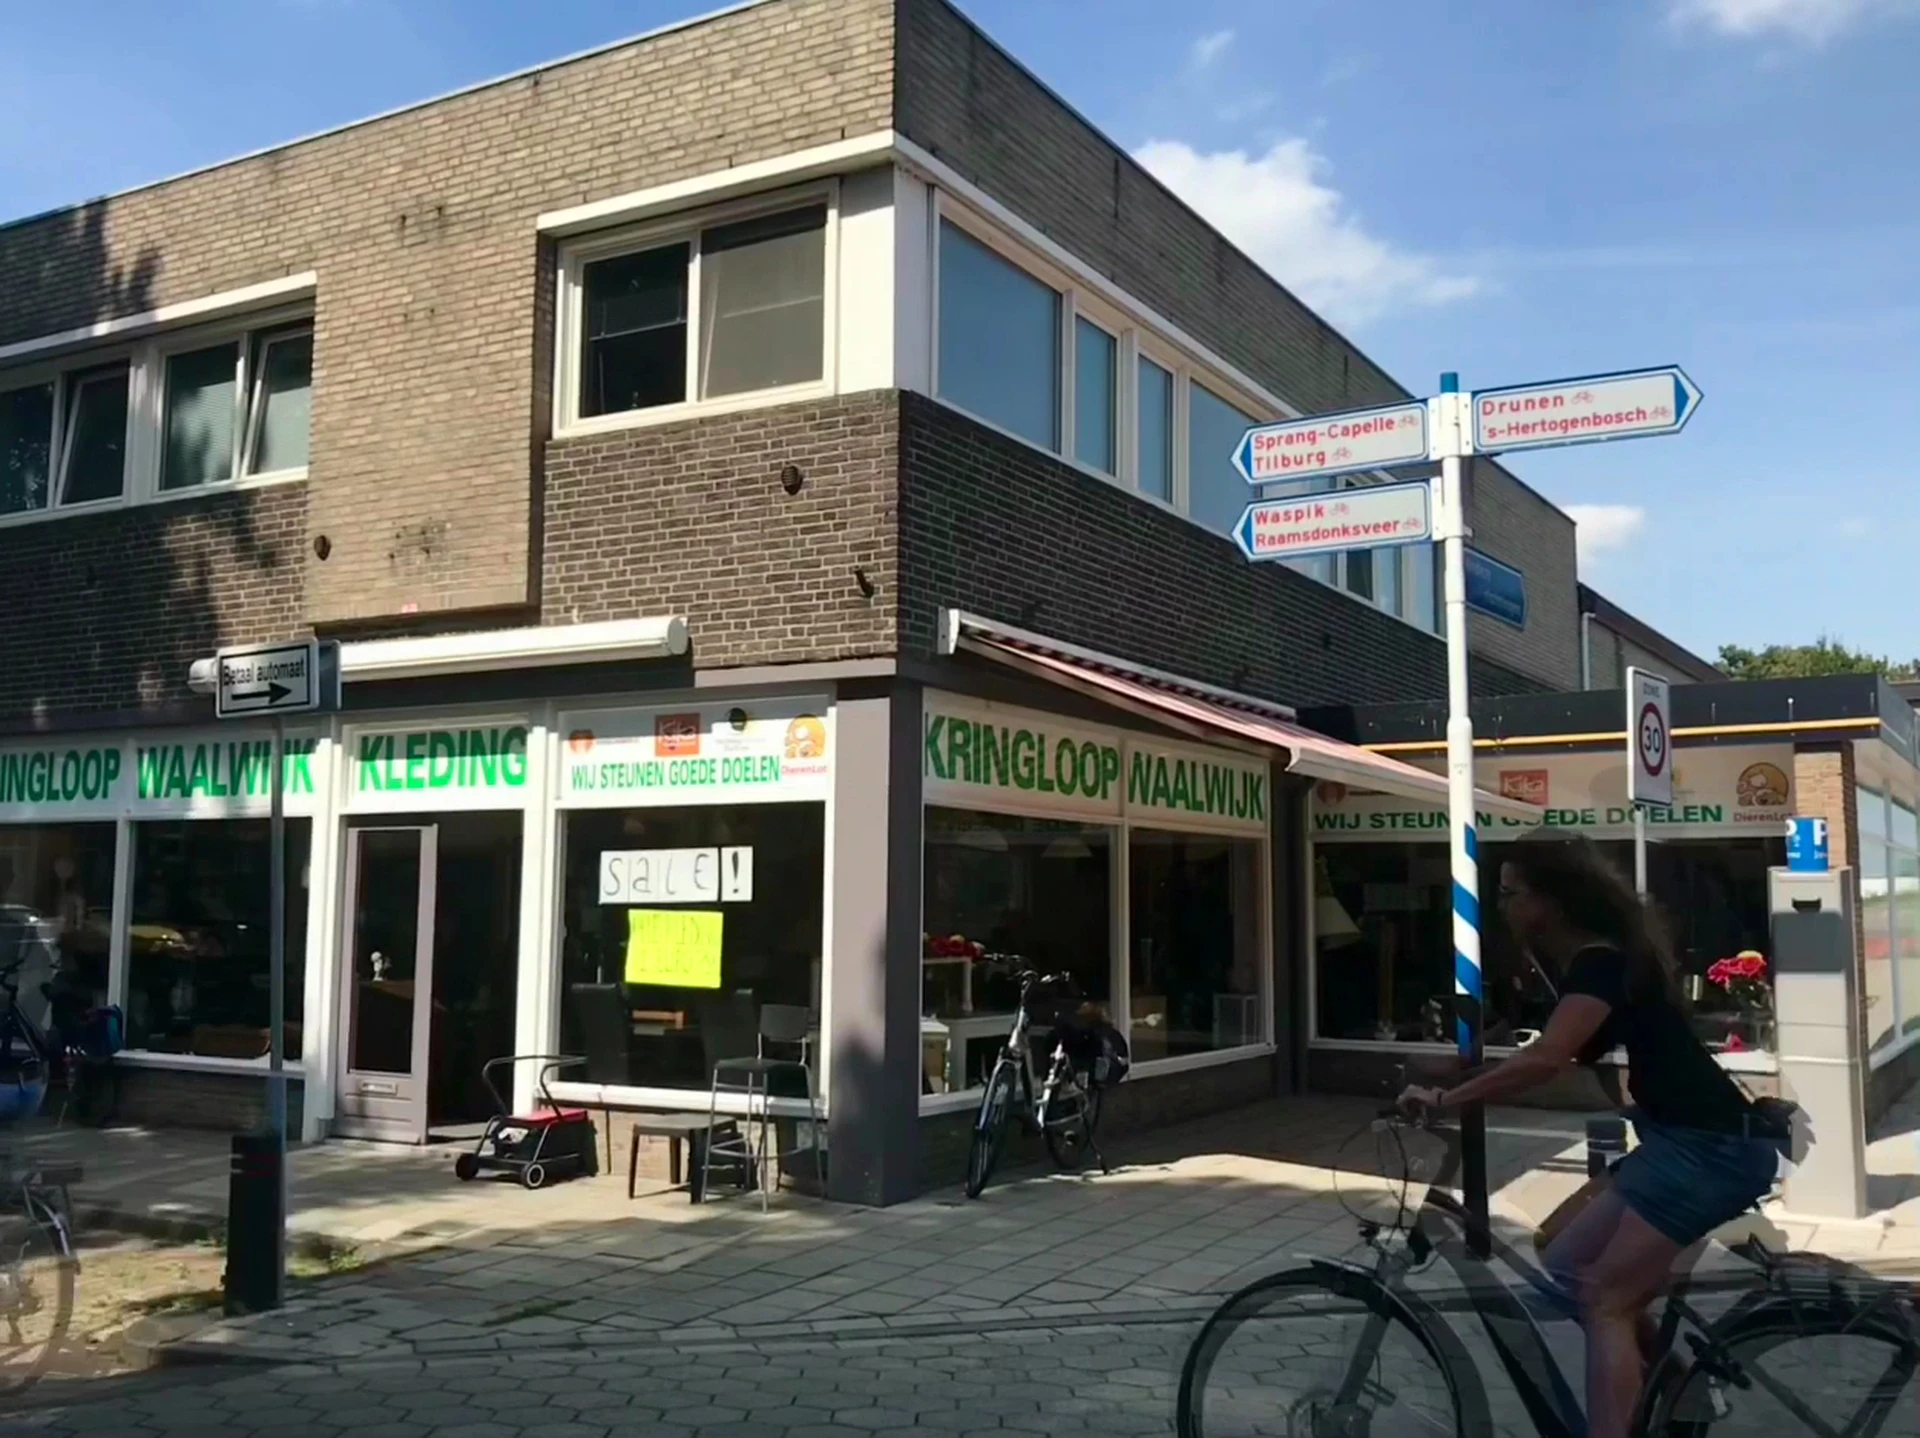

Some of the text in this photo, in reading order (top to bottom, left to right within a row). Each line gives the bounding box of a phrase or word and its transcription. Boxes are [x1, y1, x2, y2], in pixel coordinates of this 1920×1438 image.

[1482, 393, 1564, 416] Drunen
[1254, 415, 1395, 453] Sprang-Capelle
[1483, 406, 1647, 440] 's-Hertogenbosch
[1255, 449, 1326, 472] Tilburg
[1255, 503, 1324, 529] Waspik
[1256, 520, 1400, 547] Raamsdonksveer
[224, 657, 305, 686] Betaal automaat
[1644, 725, 1660, 753] 30
[358, 726, 530, 792] KLEDING
[571, 755, 780, 791] WIJ STEUNEN GOEDE DOELEN
[924, 713, 1264, 822] KRINGLOOP WAALWIJK
[0, 748, 120, 803] INGLOOP
[1315, 804, 1723, 831] WIJ STEUNN EDE DOELEN
